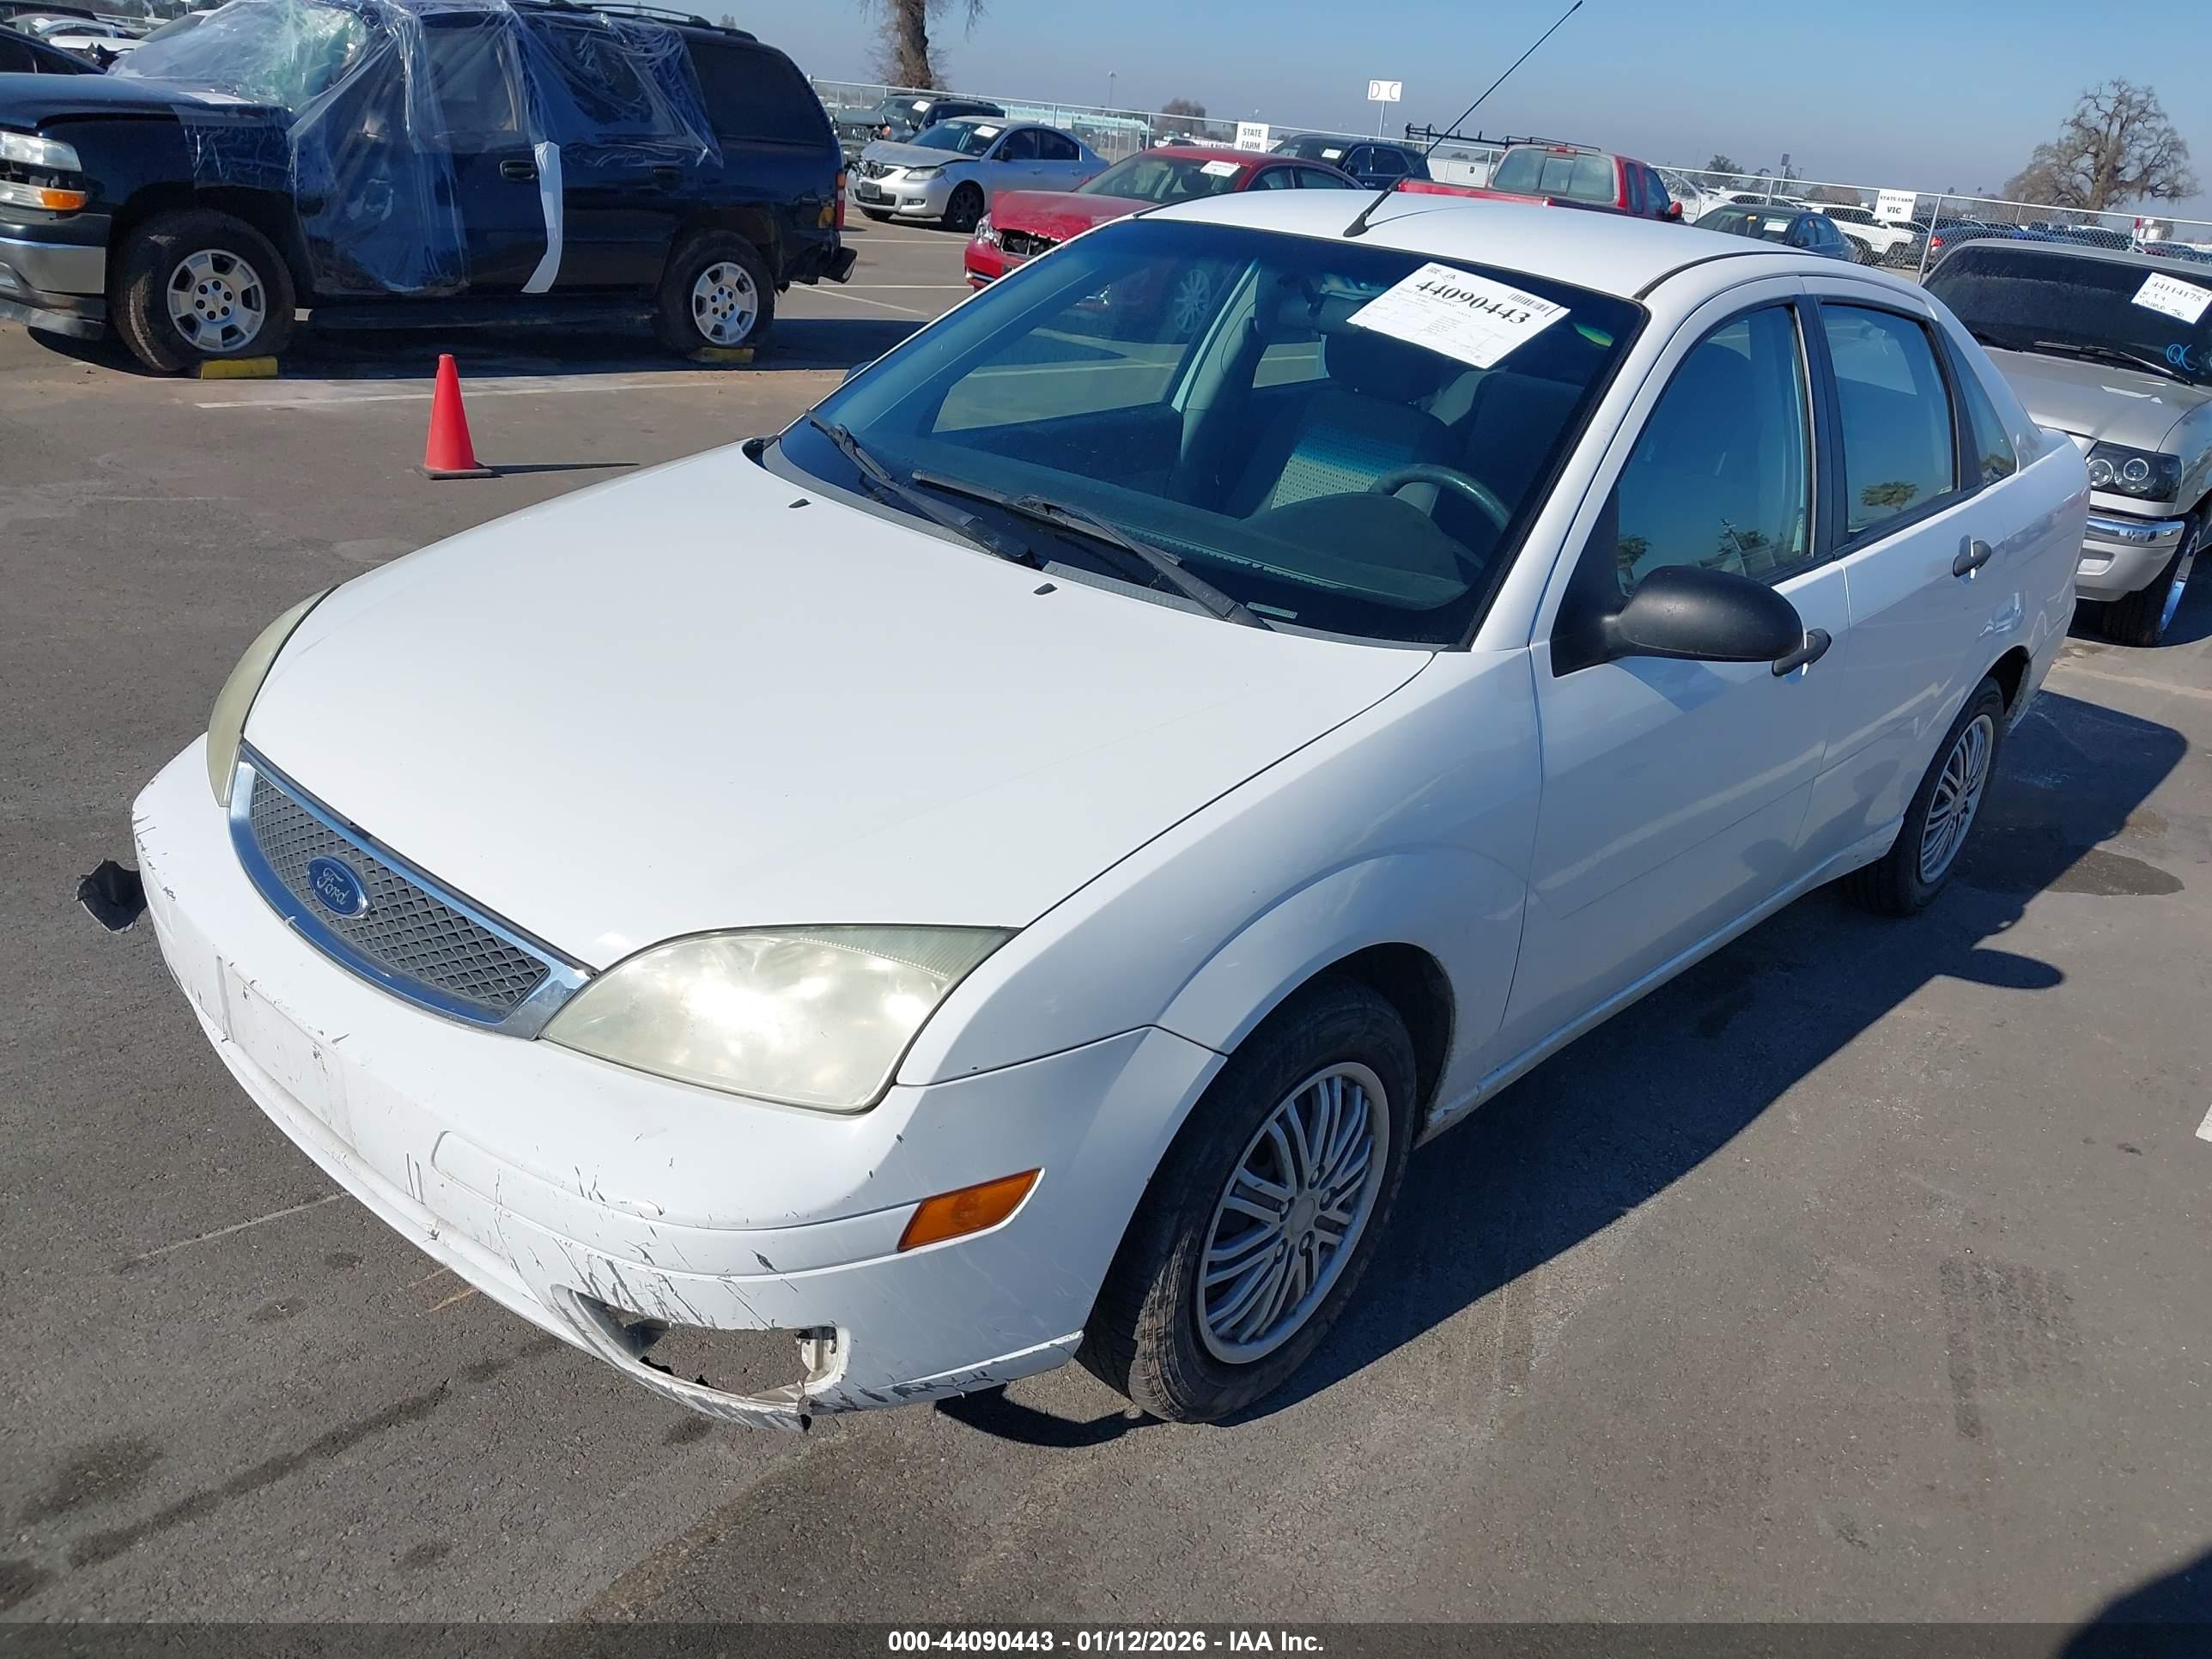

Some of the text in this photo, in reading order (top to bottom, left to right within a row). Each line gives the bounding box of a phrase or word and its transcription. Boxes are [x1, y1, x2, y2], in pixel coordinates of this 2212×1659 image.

[1370, 82, 1399, 100] D C
[1243, 127, 1263, 138] STATE
[1241, 140, 1261, 152] FARM
[2152, 282, 2203, 301] 44114175
[1415, 280, 1531, 325] 44090443
[316, 866, 351, 905] Ford
